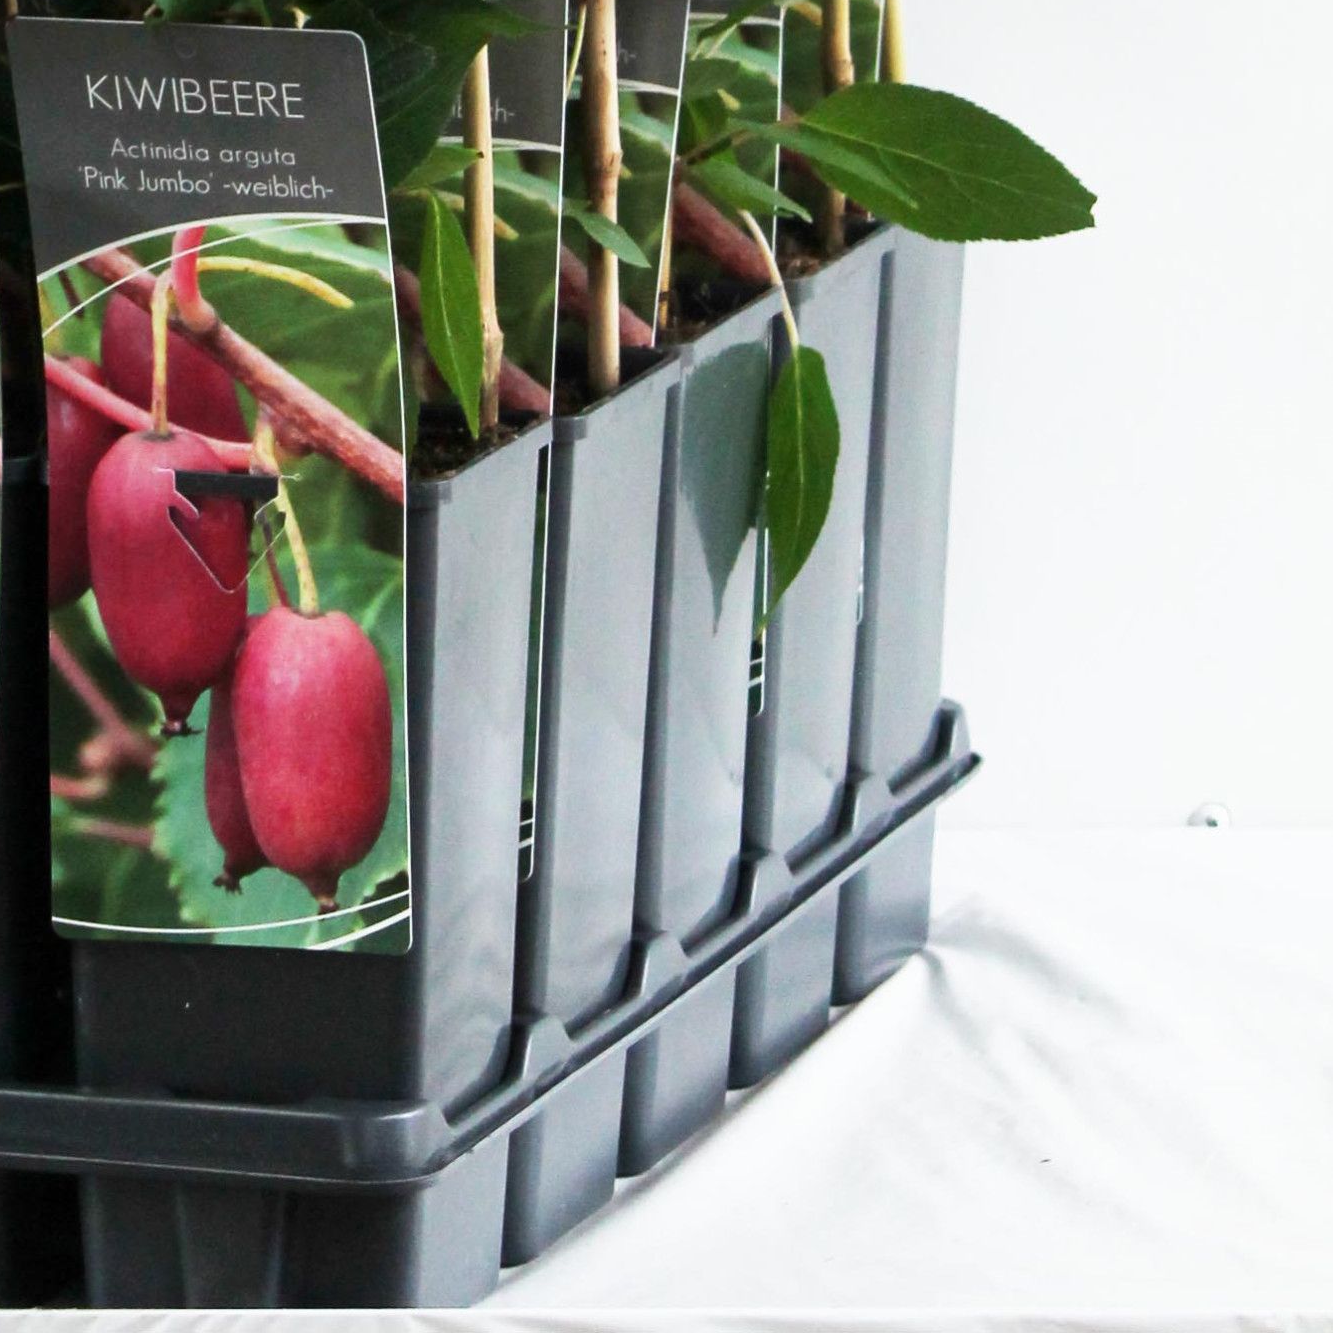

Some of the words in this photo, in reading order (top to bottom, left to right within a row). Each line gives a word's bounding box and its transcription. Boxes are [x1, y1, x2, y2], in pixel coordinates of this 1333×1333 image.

[85, 74, 305, 119] KIWIBEERE
[110, 137, 211, 163] Actinidia
[218, 147, 297, 169] arguta
[222, 174, 335, 200] -weiblich-
